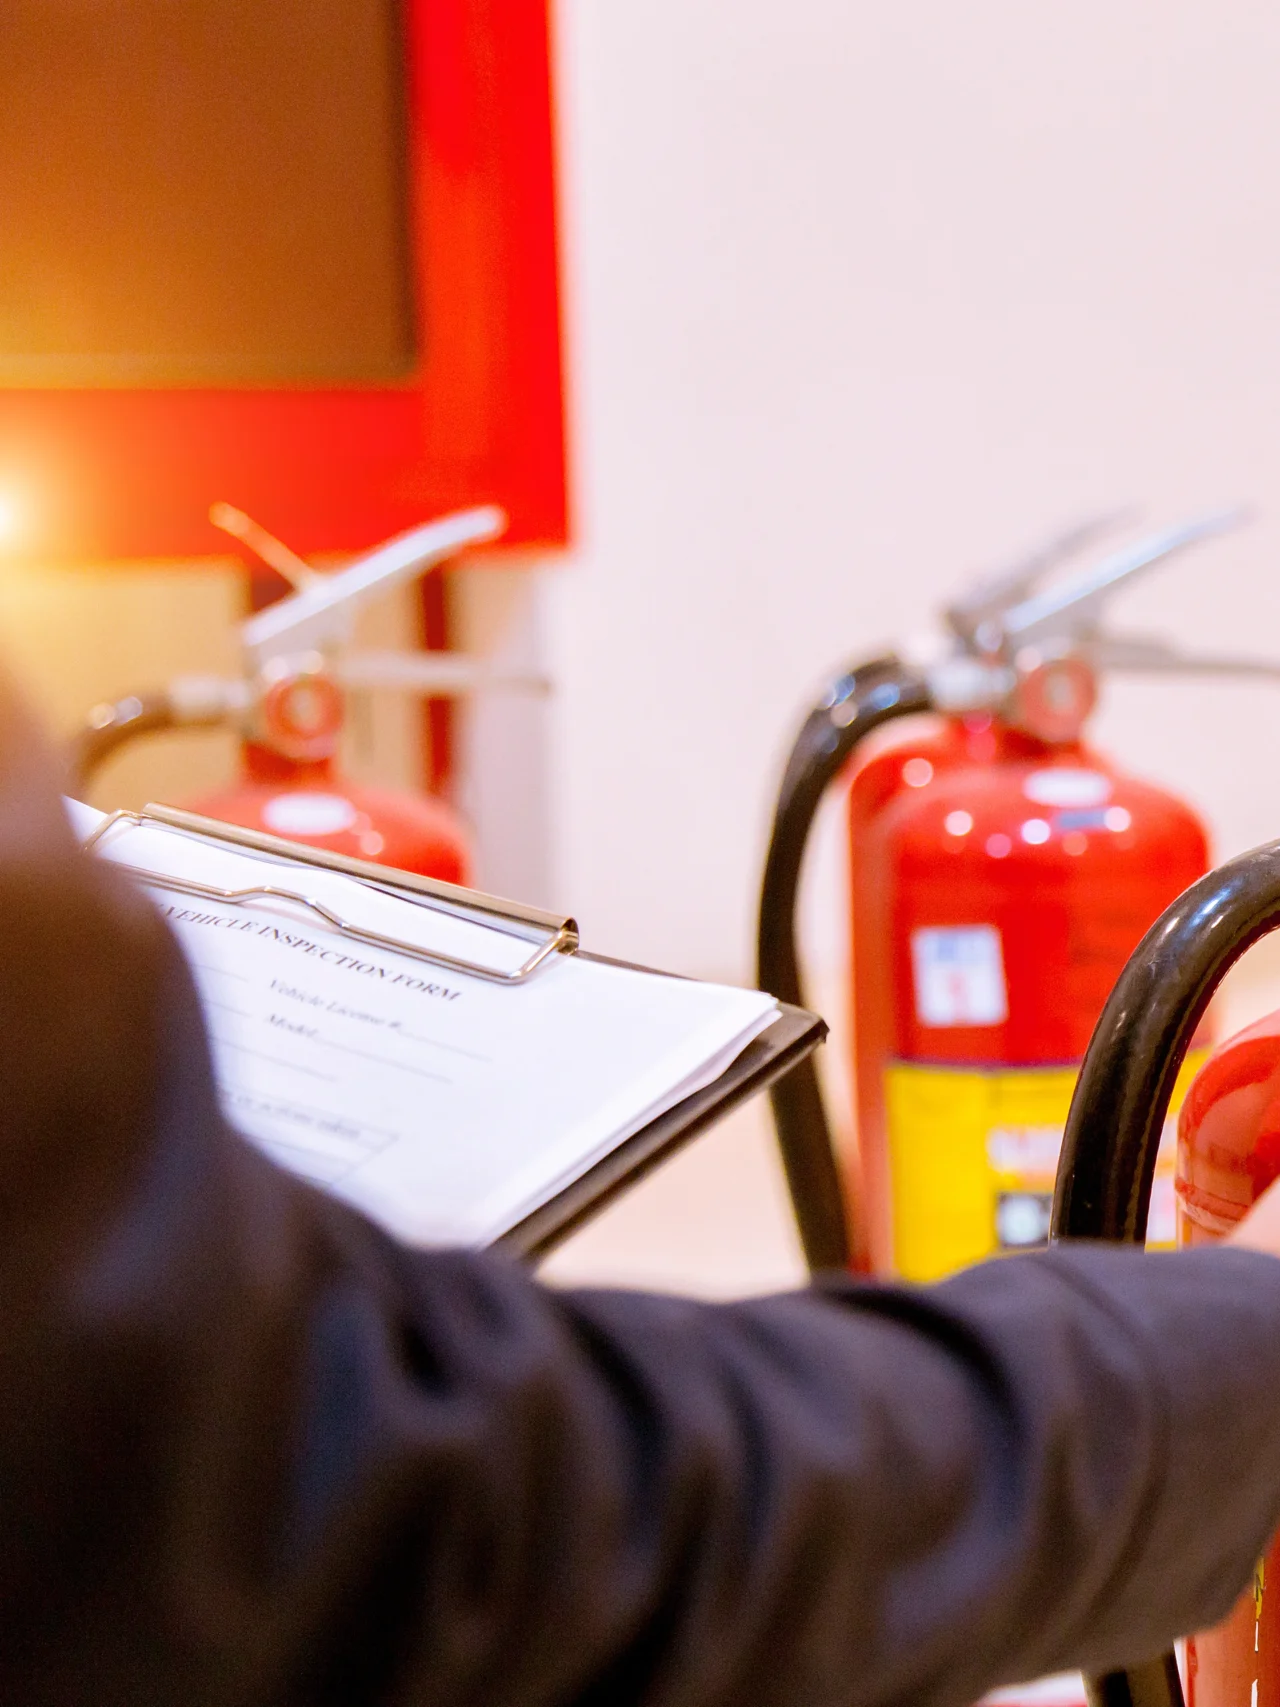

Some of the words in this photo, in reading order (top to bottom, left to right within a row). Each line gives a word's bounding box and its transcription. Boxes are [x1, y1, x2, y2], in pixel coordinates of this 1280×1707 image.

[165, 905, 258, 932] VEHICLE
[257, 926, 393, 979] INSPECTION
[391, 973, 463, 1001] FORM
